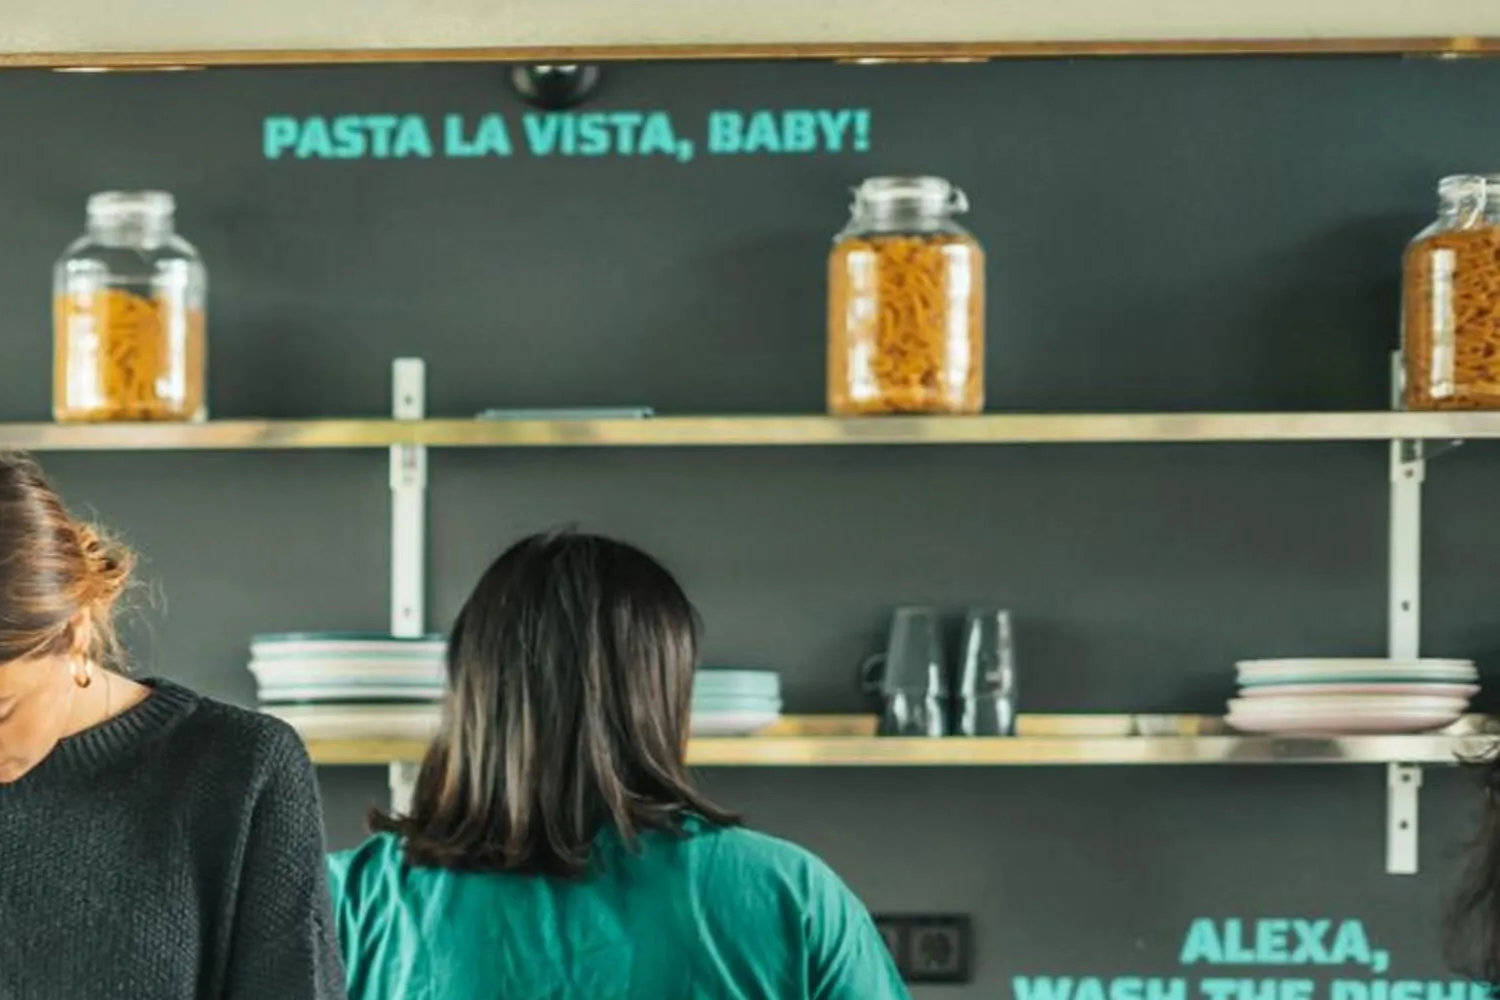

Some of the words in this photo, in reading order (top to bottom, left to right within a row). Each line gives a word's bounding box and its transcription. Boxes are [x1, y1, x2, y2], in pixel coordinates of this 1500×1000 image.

[262, 113, 434, 160] PASTA
[443, 113, 514, 158] LA
[521, 110, 695, 163] VISTA,
[707, 108, 871, 155] BABY!
[1181, 918, 1390, 972] ALEXA,
